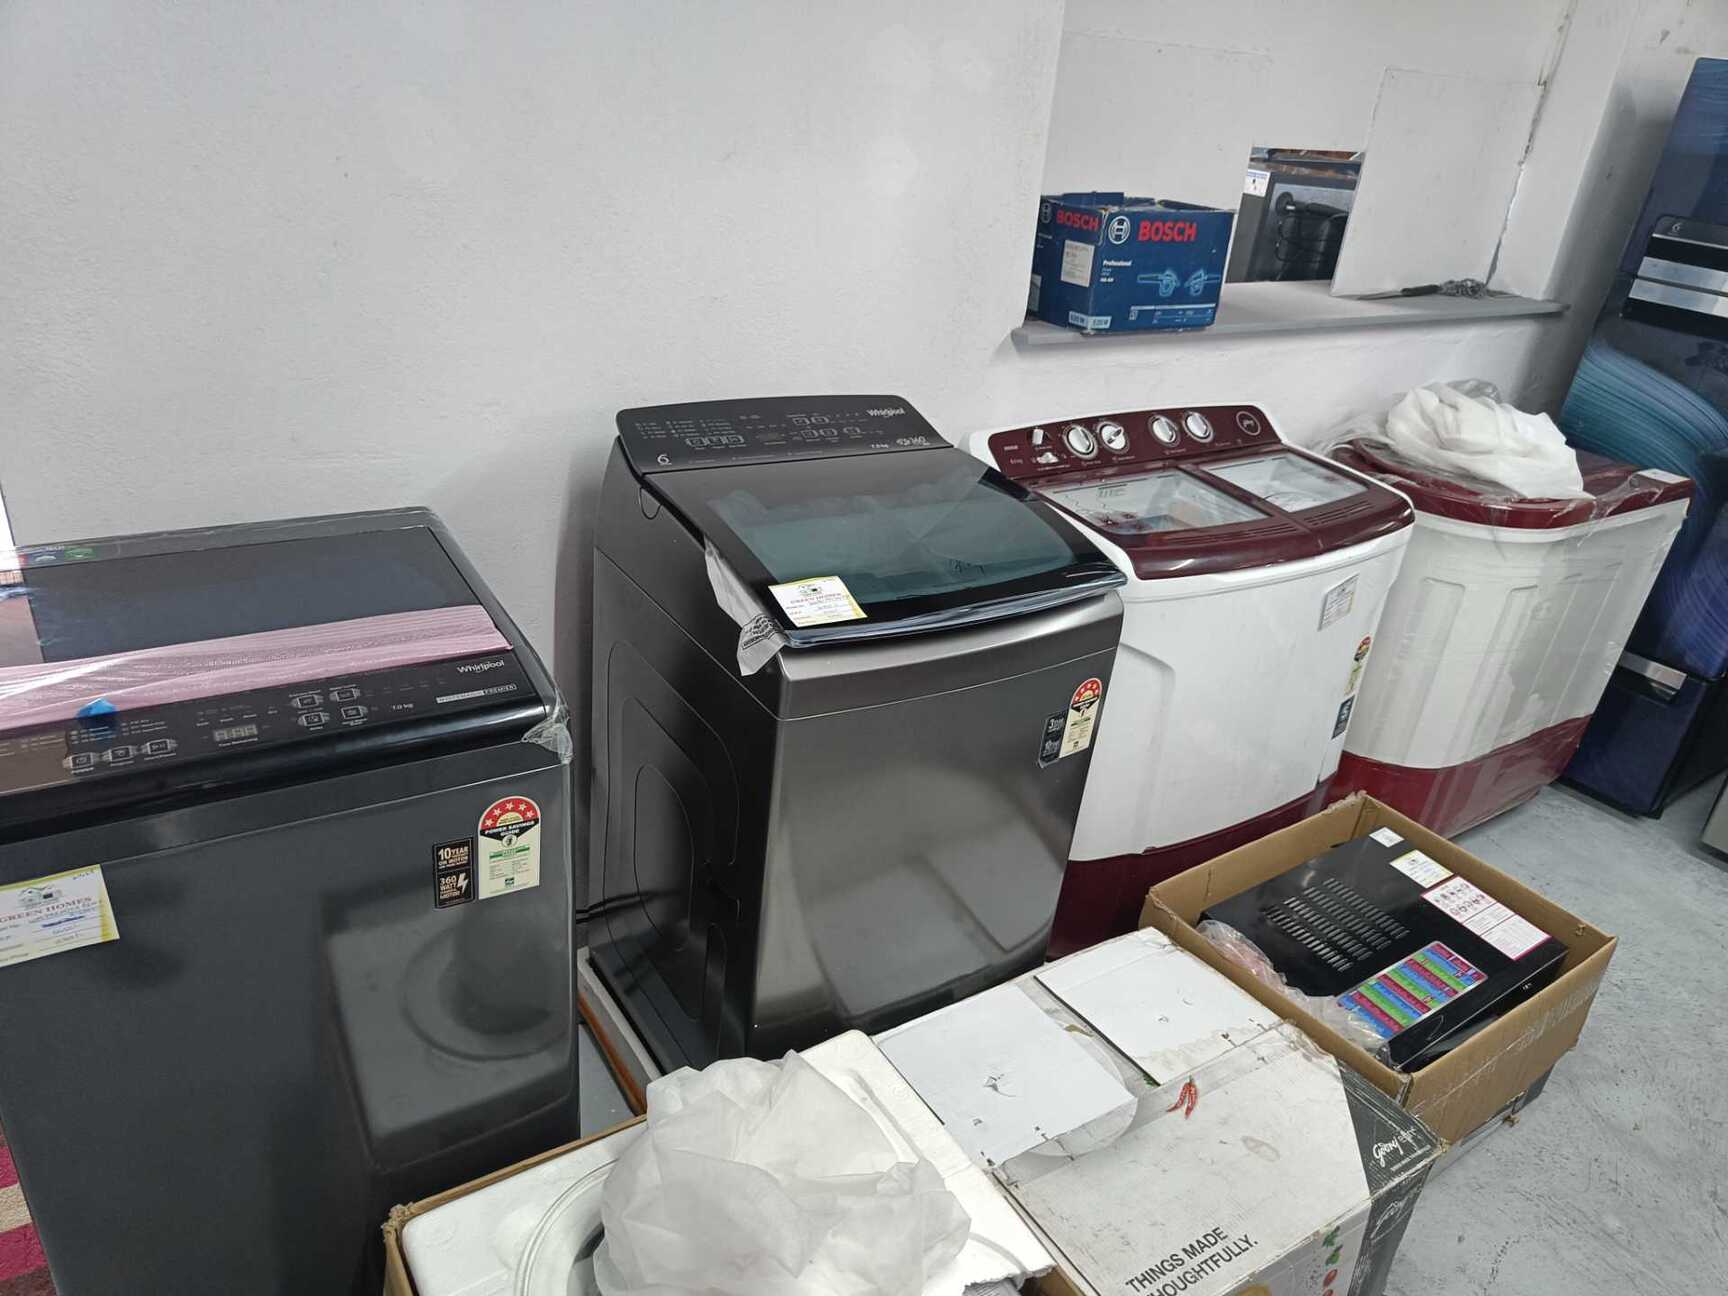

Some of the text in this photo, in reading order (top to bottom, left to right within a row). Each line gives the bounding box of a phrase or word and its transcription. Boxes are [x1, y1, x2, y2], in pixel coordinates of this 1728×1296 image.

[1056, 209, 1099, 231] BOSCH
[1138, 220, 1198, 243] BOSCH
[456, 660, 504, 673] Whirlpool
[438, 847, 451, 860] 10
[47, 897, 92, 912] HOMES
[1125, 1227, 1229, 1292] THINGS MADE
[1146, 1234, 1258, 1296] HOUGHTFULLY.
